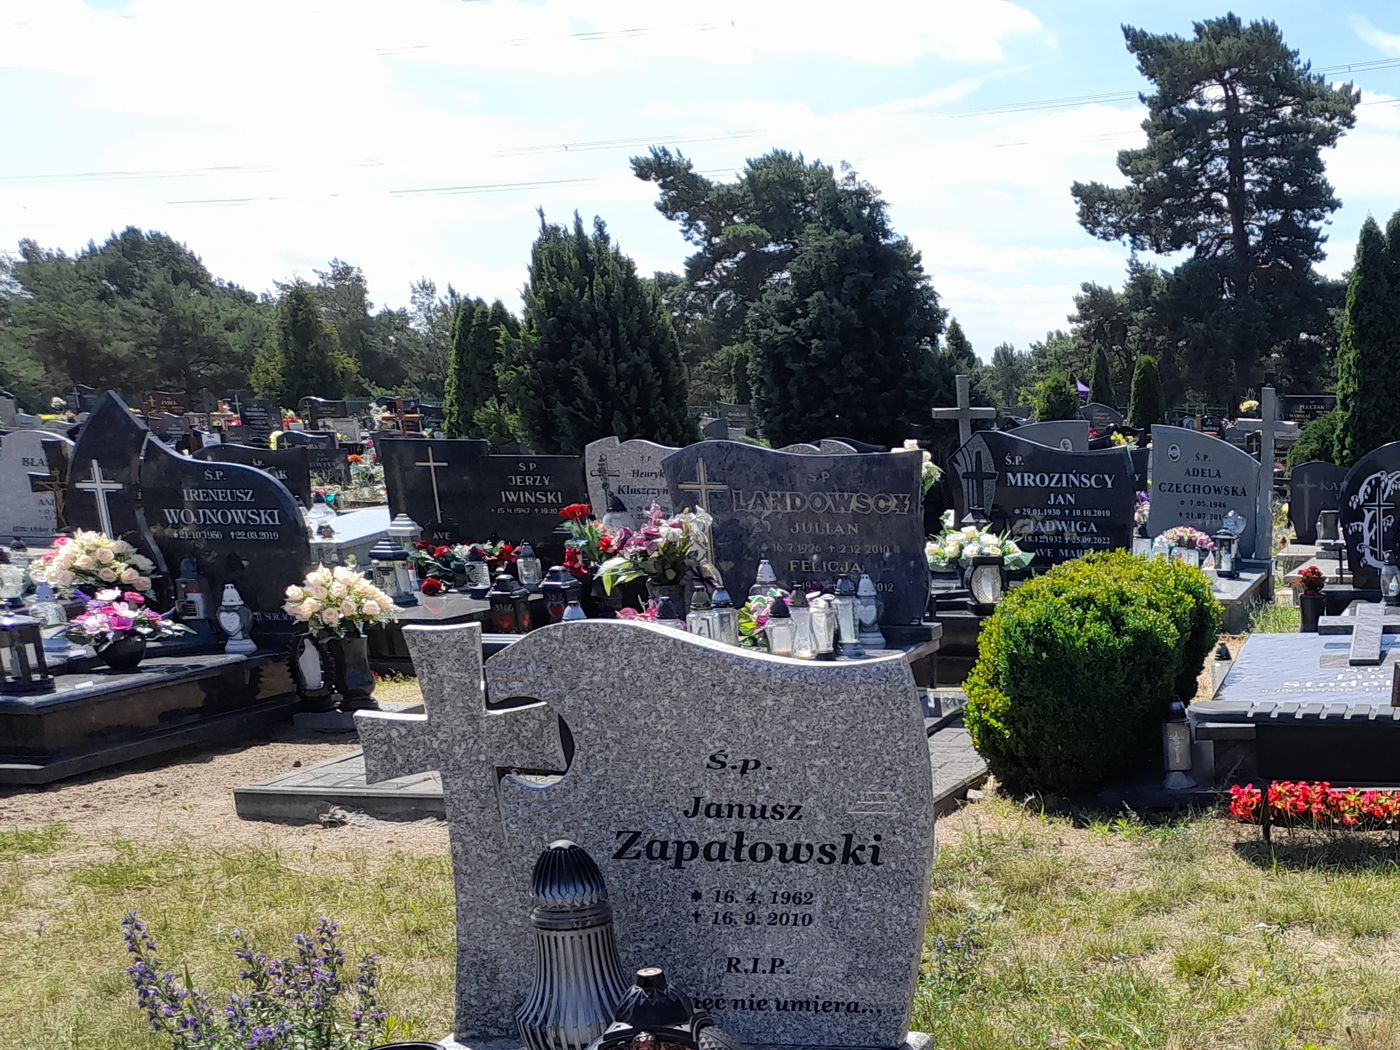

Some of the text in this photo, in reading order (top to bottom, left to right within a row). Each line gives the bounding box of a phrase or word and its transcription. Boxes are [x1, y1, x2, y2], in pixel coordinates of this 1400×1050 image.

[1005, 453, 1024, 465] Ś.P.
[632, 469, 665, 480] Henryk
[1006, 469, 1115, 489] MROZIŃSCY
[1184, 467, 1222, 479] ADELA
[508, 475, 550, 486] JERZY
[182, 488, 255, 502] IRENEUSZ
[501, 489, 563, 503] IWIŃSKI
[1158, 482, 1247, 497] CZECHOWSKA
[732, 490, 911, 515] LANDOWSCY
[1047, 493, 1076, 505] JAN
[163, 508, 281, 525] WOJNOWSKI
[790, 522, 859, 535] JULIAN
[1029, 520, 1098, 533] JADWIGA
[432, 531, 451, 540] AVE
[789, 560, 861, 573] FELICJA
[682, 796, 803, 821] Janusz
[611, 829, 885, 870] Zapałowski
[770, 890, 815, 905] 1962
[766, 912, 814, 927] 2010
[724, 956, 792, 975] R.I.P.
[733, 993, 768, 1012] nie
